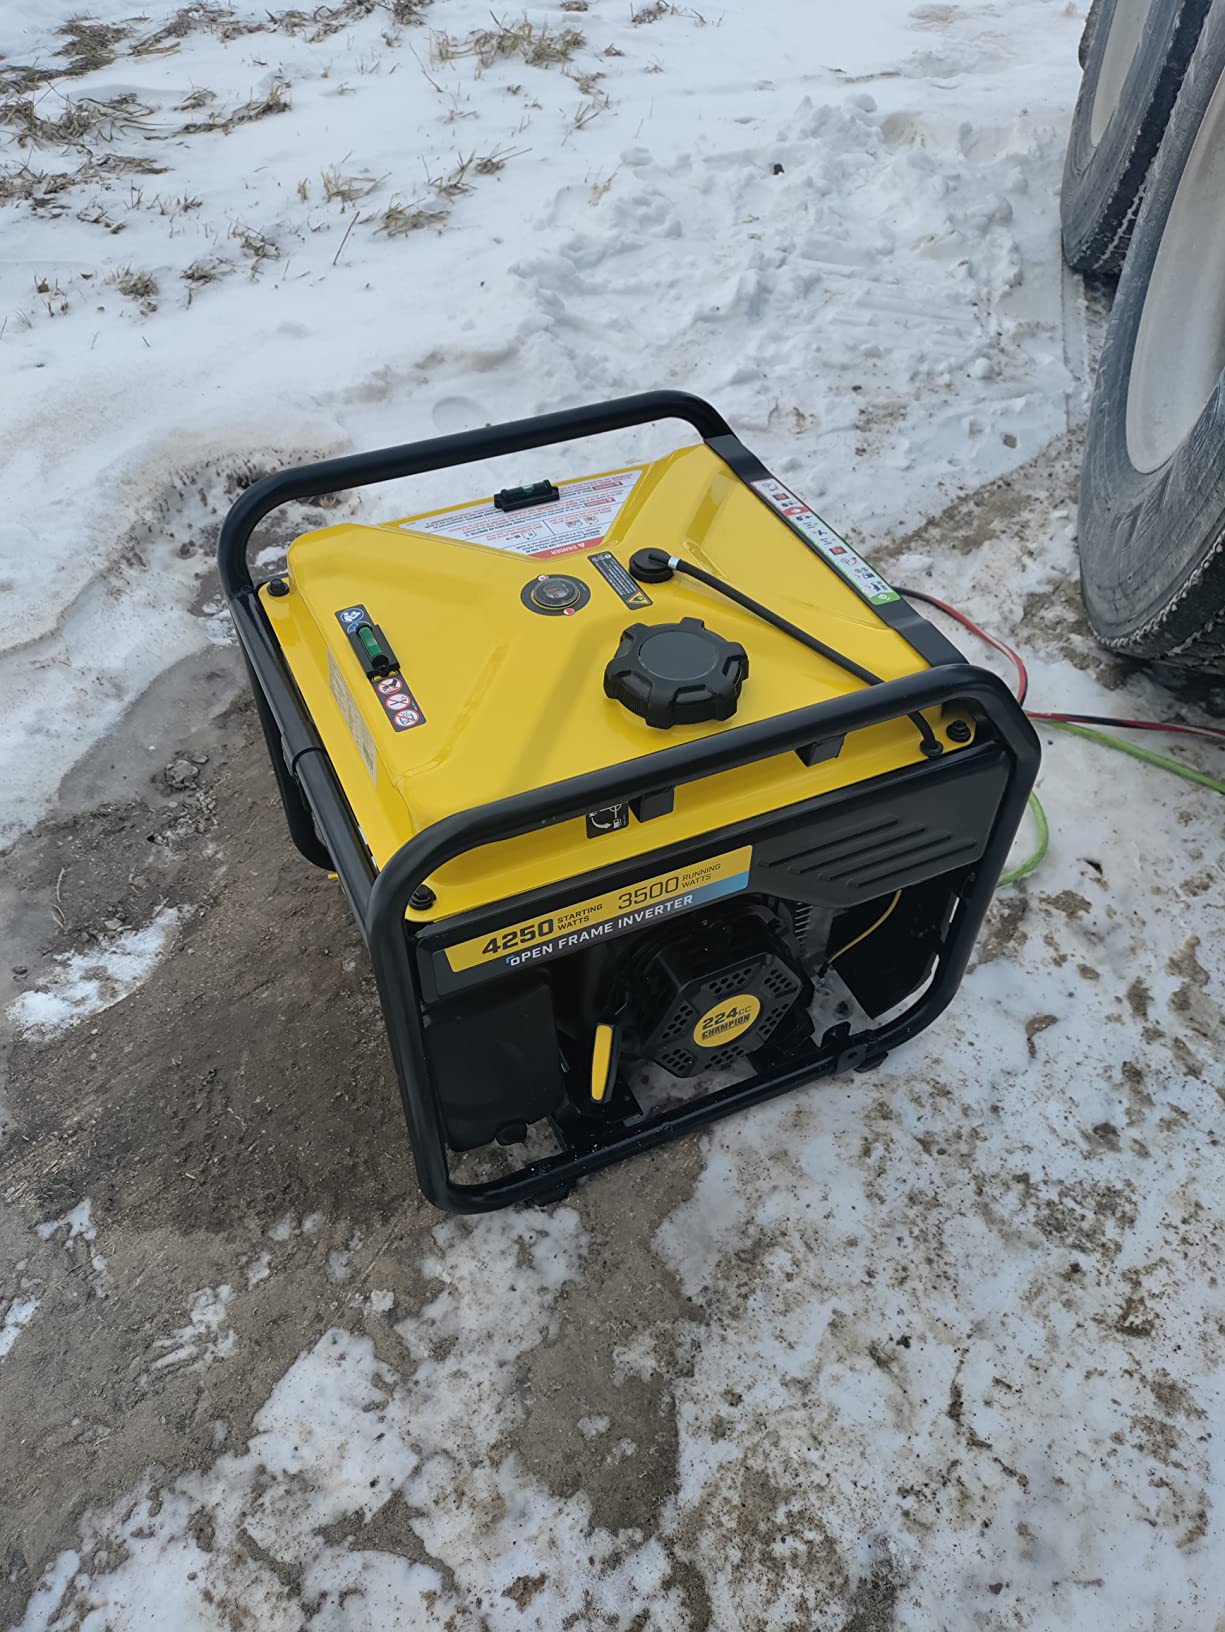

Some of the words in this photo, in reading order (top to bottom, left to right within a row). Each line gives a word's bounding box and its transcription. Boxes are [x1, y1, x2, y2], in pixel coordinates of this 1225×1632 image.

[681, 874, 712, 888] WATTS
[682, 864, 721, 881] RUNNING
[618, 876, 680, 910] 3500
[557, 904, 603, 924] STARTING
[557, 916, 590, 931] WATTS
[482, 919, 554, 954] 4250
[506, 944, 553, 966] OPEN
[559, 922, 614, 950] FRAME
[618, 894, 694, 928] INVERTER
[702, 1013, 751, 1040] CHAMPION
